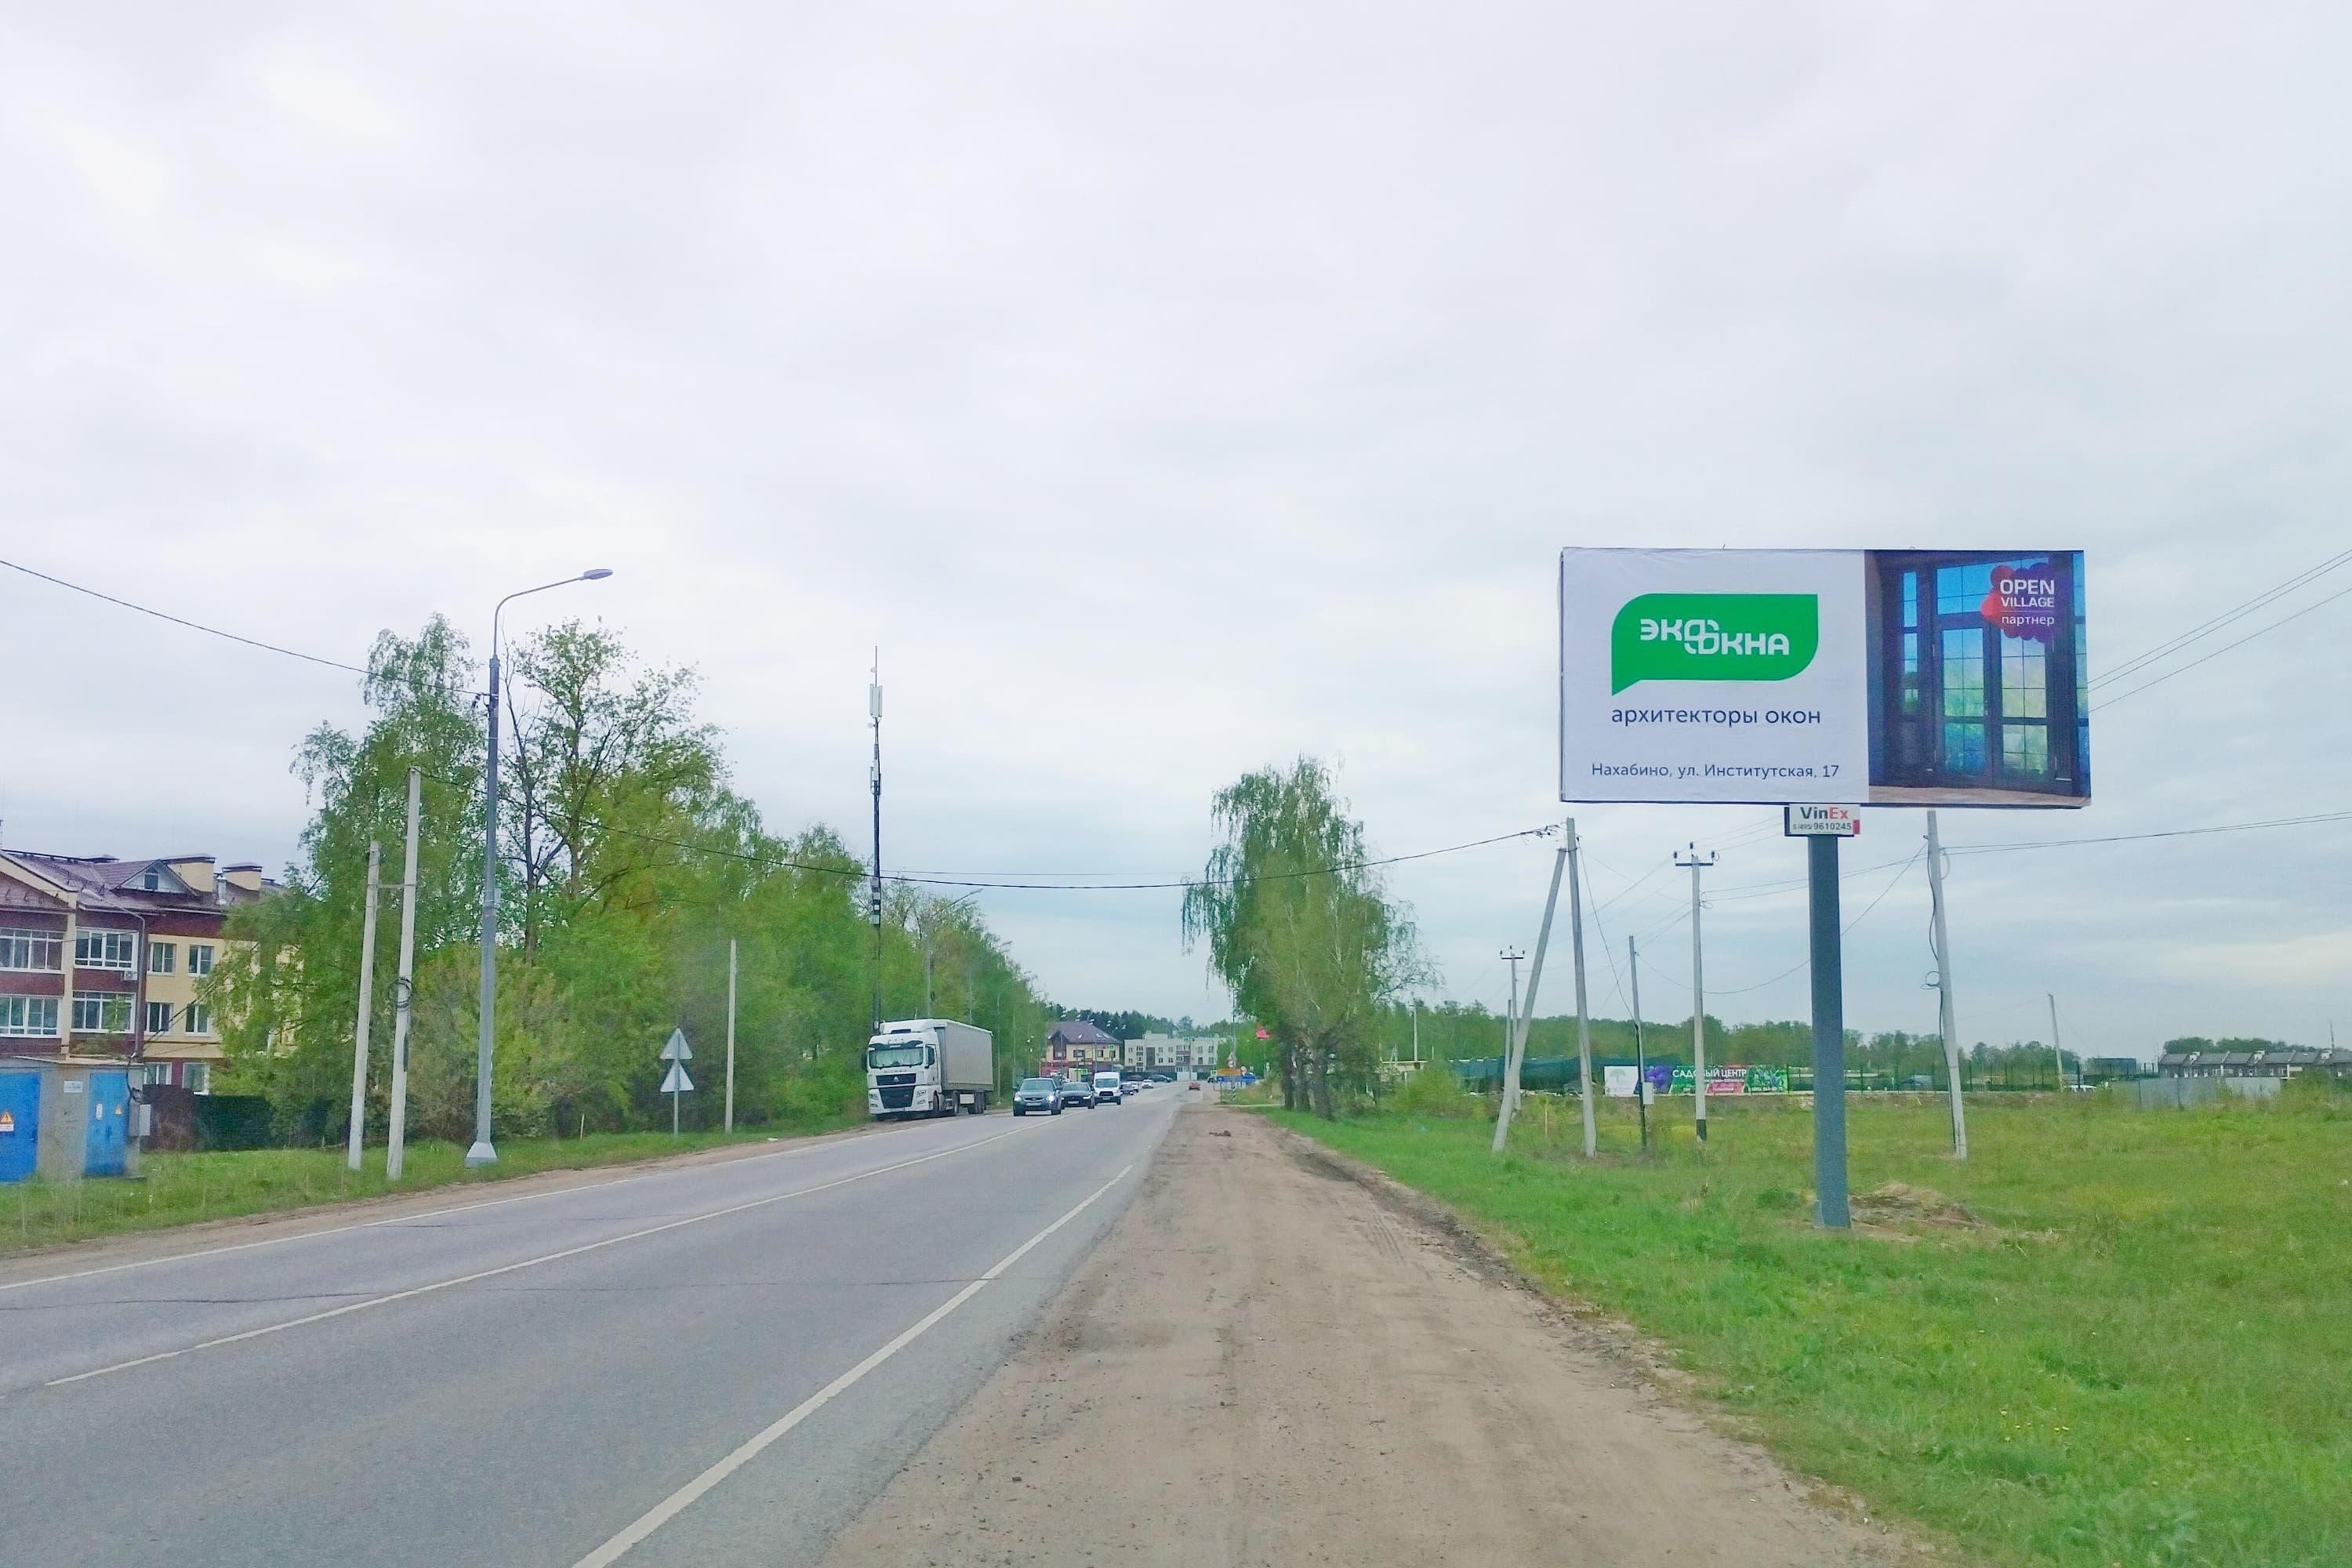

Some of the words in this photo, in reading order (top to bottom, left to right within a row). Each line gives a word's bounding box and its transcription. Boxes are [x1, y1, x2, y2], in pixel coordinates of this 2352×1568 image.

[2000, 579, 2054, 594] OPEN
[2001, 597, 2054, 608] VILLAGE
[2002, 616, 2055, 626] партнер
[1611, 708, 1758, 728] архитекторы
[1765, 710, 1821, 724] окон
[1592, 763, 1672, 778] Нахабино,
[1678, 768, 1699, 779] ул.
[1704, 764, 1817, 779] Институтская,
[1822, 764, 1839, 777] 17
[1800, 807, 1849, 819] VinEx
[1672, 1068, 1720, 1079] САДЫЙ
[1721, 1069, 1747, 1078] ЦЕНТР
